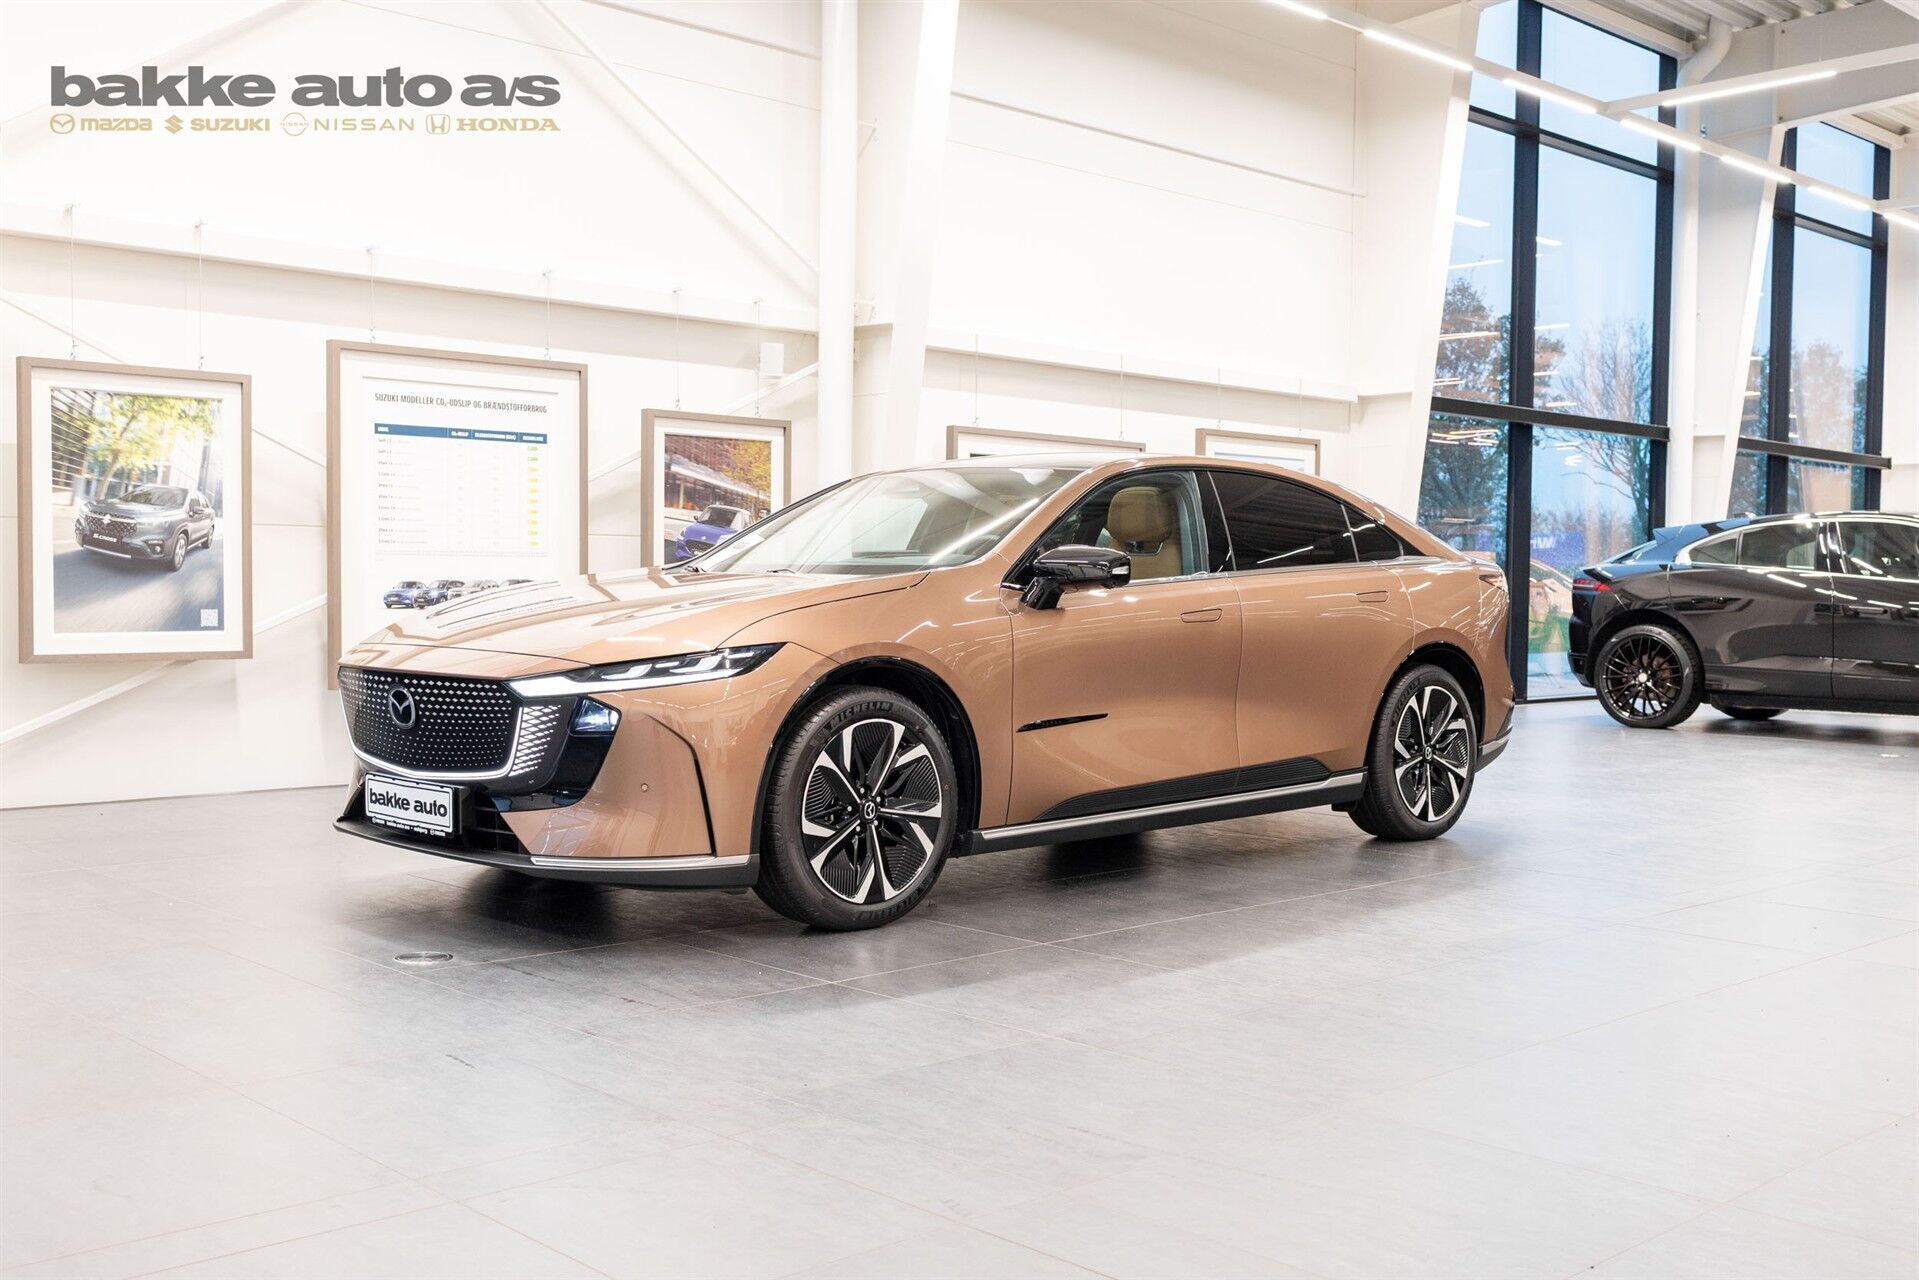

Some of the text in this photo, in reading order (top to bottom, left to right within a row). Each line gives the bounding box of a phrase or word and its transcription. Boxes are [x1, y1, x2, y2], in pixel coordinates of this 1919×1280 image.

[374, 393, 399, 403] SUZUKI
[400, 396, 434, 406] MODELLER
[473, 401, 482, 409] OG
[370, 788, 447, 817] bakke auto
